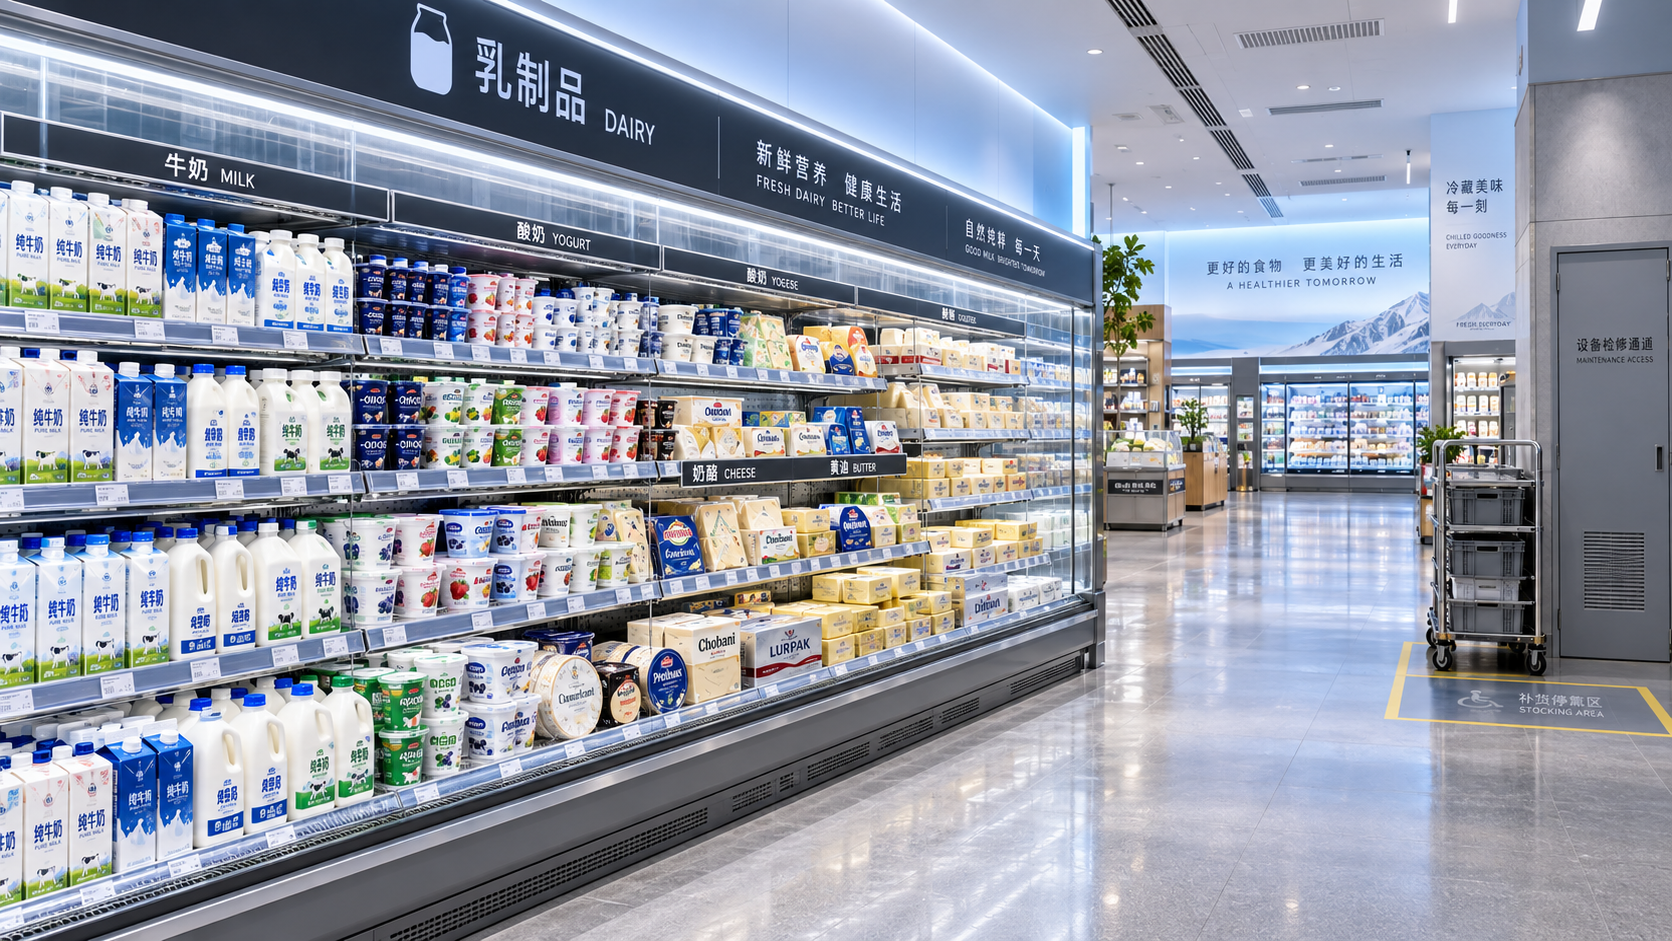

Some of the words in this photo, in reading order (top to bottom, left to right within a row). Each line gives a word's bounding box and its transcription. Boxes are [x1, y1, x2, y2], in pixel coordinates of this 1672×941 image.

[475, 36, 586, 125] 乳制品
[604, 108, 656, 146] DAIRY
[164, 152, 209, 182] 牛奶
[756, 138, 828, 187] 新鲜营养
[844, 171, 901, 214] 健康生活
[220, 168, 256, 189] MILK
[1446, 178, 1503, 195] 冷藏美味
[756, 174, 791, 197] FRESH
[795, 187, 827, 208] DAIRY
[832, 199, 866, 220] BETTER
[868, 211, 885, 227] LIFE
[516, 221, 546, 244] 酸奶
[552, 232, 592, 251] YOGURT
[16, 233, 44, 254] 纯牛奶
[56, 238, 83, 258] 纯牛奶
[1206, 258, 1282, 276] 更好的食物
[1302, 253, 1404, 272] 更美好的生活
[1227, 282, 1234, 290] A
[1238, 279, 1300, 290] HEALTHIER
[1306, 276, 1377, 287] TOMORROW
[1576, 356, 1625, 364] MAINTENANCE
[1627, 355, 1654, 363] ACCESS
[33, 407, 63, 427] 纯牛奶
[79, 408, 107, 427] 纯牛奶
[692, 463, 718, 483] 奶酪
[724, 467, 756, 479] CHEESE
[852, 462, 877, 473] BUTTER
[698, 632, 736, 653] Chobani
[769, 637, 811, 658] LURPAK
[1519, 706, 1573, 716] STOCKING
[1575, 709, 1605, 718] AREA
[77, 808, 106, 832] 纯牛奶
[33, 819, 63, 844] 纯牛奶
